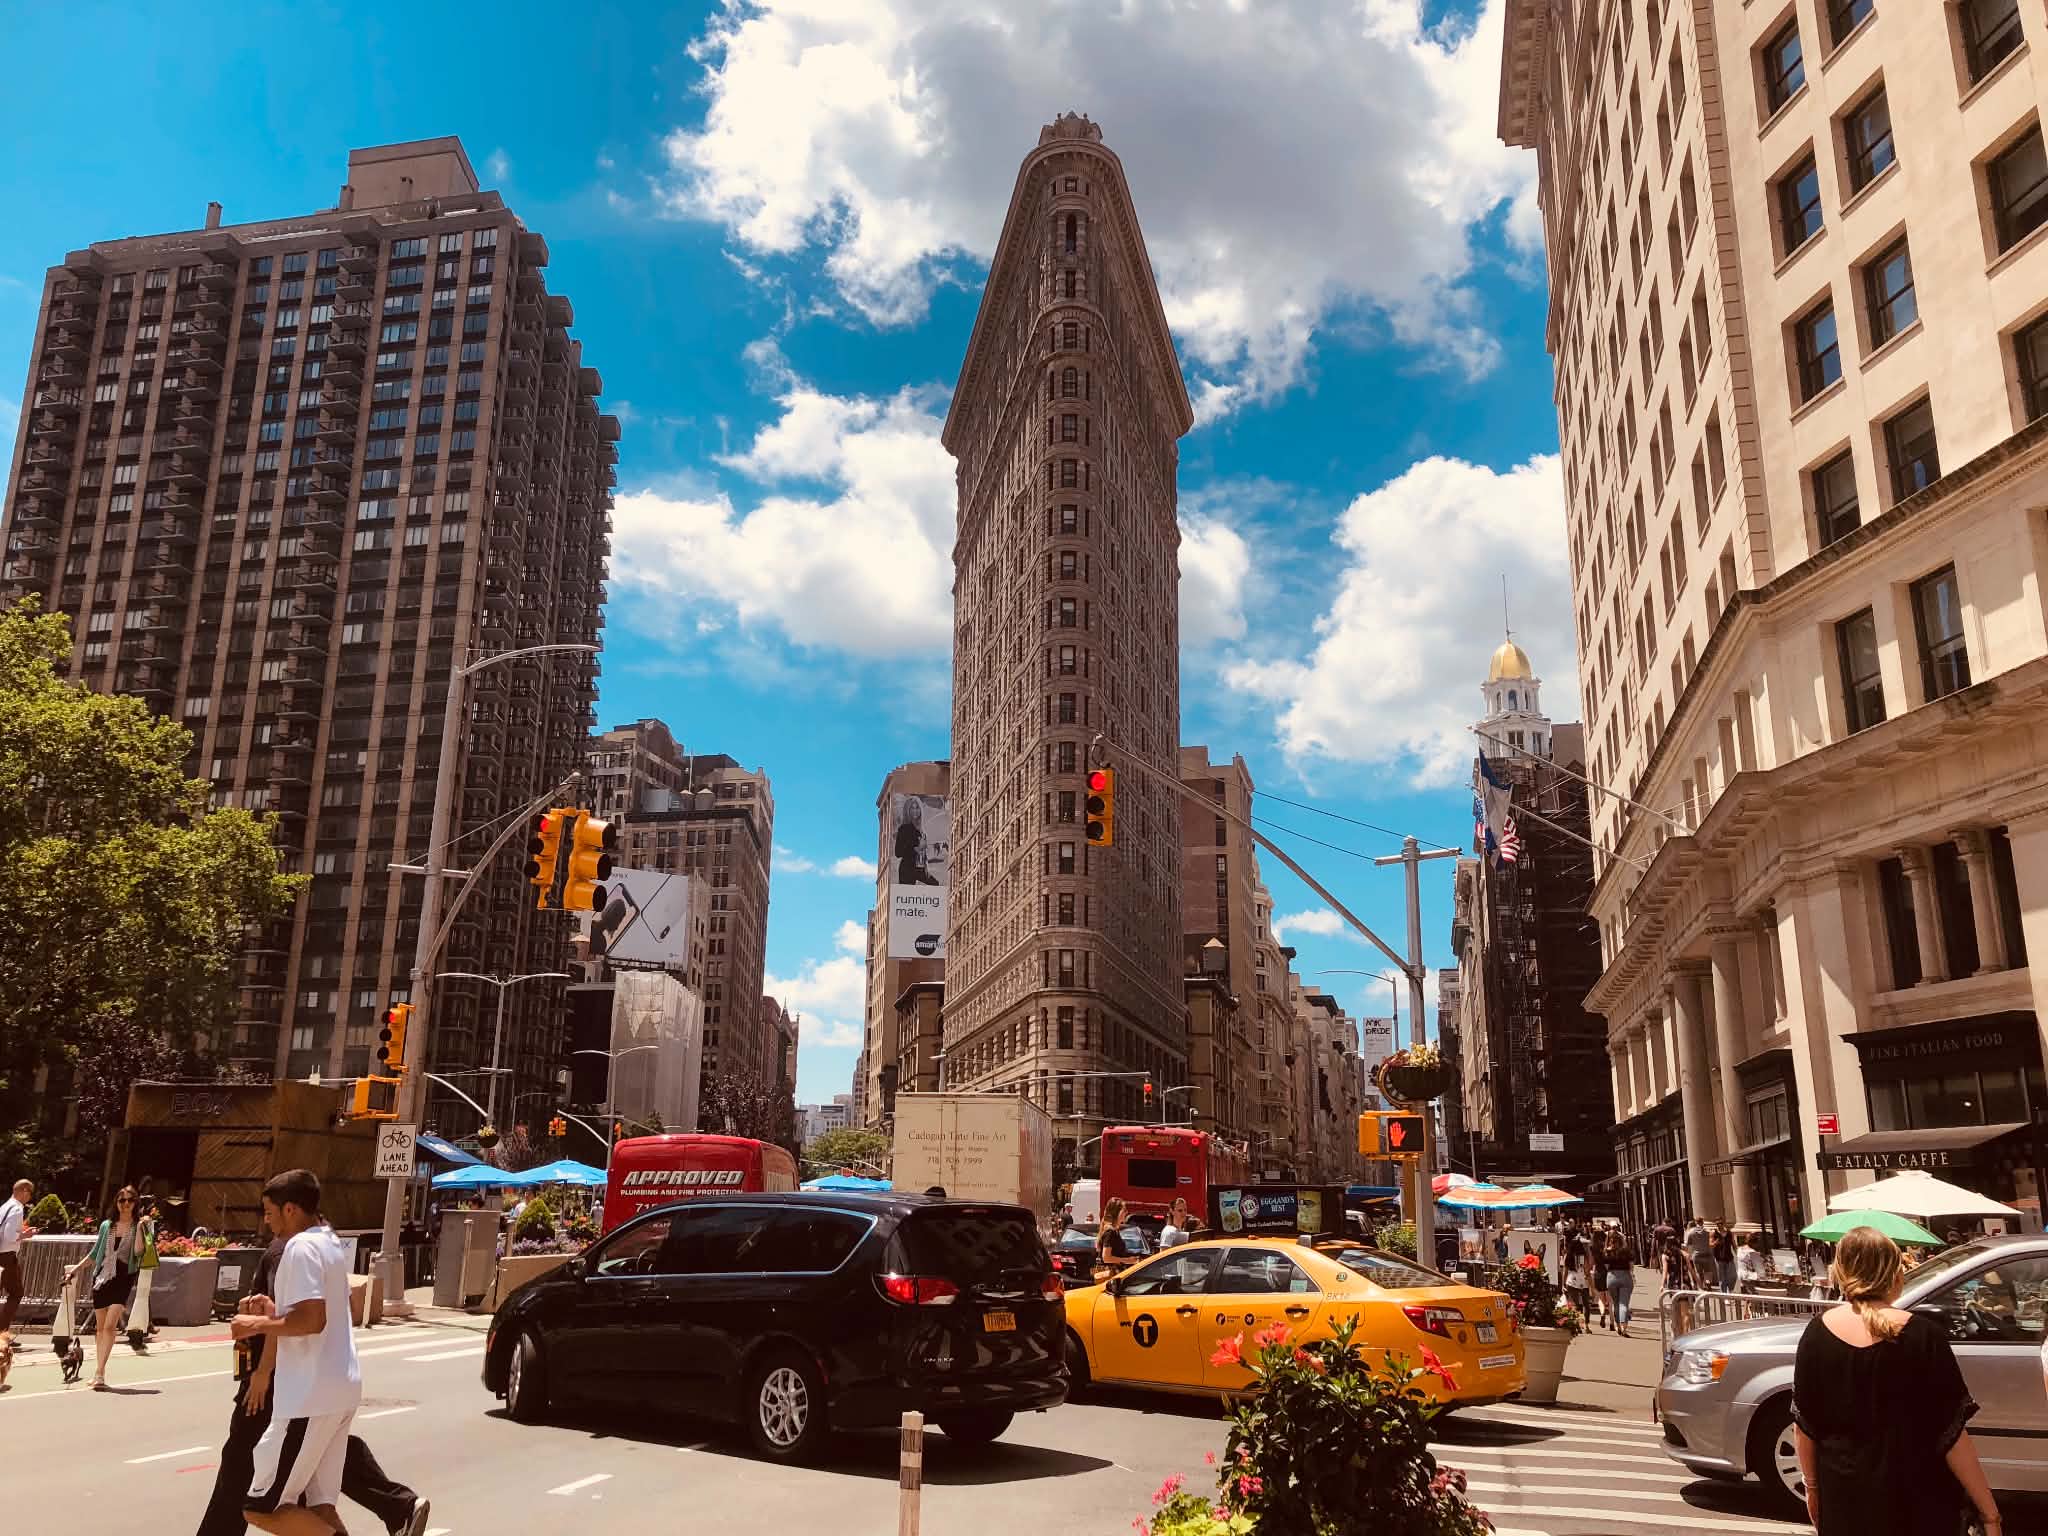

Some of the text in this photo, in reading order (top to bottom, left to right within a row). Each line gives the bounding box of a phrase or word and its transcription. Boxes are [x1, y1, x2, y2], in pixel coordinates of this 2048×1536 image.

[896, 895, 940, 907] running
[896, 907, 928, 918] mate.
[1870, 1032, 2004, 1058] FINE ITALIAN FOOD
[908, 1130, 946, 1143] Cadogan
[972, 1130, 990, 1141] Fine
[993, 1131, 1006, 1141] Art
[384, 1152, 406, 1162] LANE
[1836, 1152, 1949, 1168] EATALY CAFFE
[380, 1164, 409, 1173] AHEAD
[623, 1170, 744, 1186] APPROVED
[1138, 1320, 1153, 1343] T
